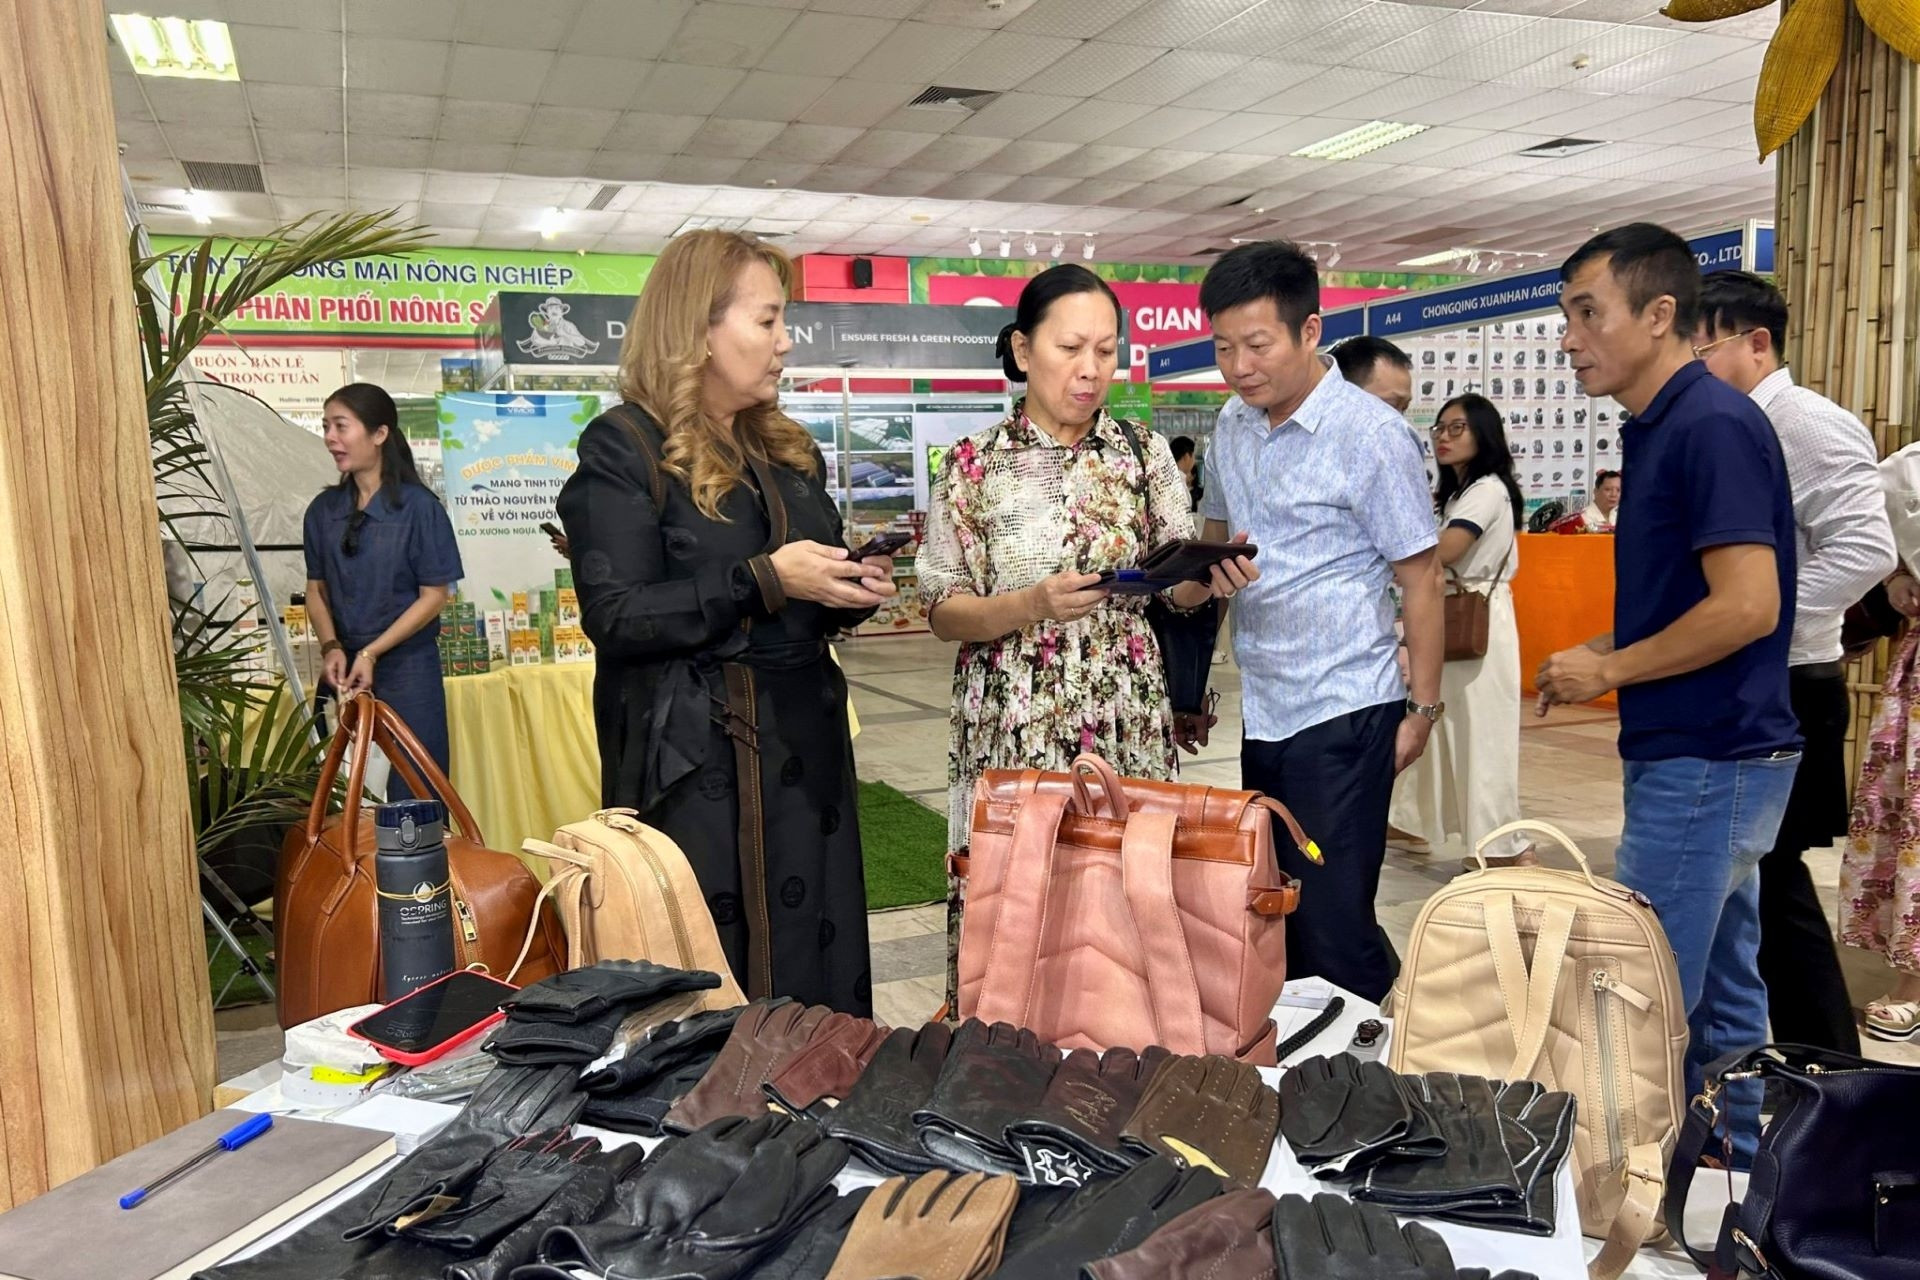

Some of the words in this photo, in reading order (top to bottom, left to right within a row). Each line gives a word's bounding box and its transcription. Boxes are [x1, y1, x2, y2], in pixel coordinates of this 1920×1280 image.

[1718, 245, 1742, 262] LTD
[354, 261, 398, 285] MẠI
[406, 259, 477, 284] NÔNG
[485, 263, 573, 289] NGHIỆP
[237, 292, 311, 321] PHÂN
[320, 291, 381, 322] PHỐI
[389, 294, 460, 324] NÔNG
[1385, 312, 1401, 325] A44
[1422, 299, 1478, 319] CHONGQING
[1479, 287, 1529, 308] XUANHAN
[1531, 281, 1563, 298] AGRIC
[1135, 306, 1202, 331] GIAN
[841, 333, 879, 342] ENSURE
[880, 334, 910, 342] FRESH
[911, 334, 919, 343] &
[920, 335, 951, 343] GREEN
[952, 335, 998, 344] FOODSTUF
[194, 353, 237, 368] BUÔN
[1160, 358, 1170, 368] A41
[551, 455, 577, 472] VIM
[490, 480, 521, 488] MANG
[524, 479, 547, 488] TINH
[504, 495, 547, 505] NGUYÊN
[458, 528, 477, 537] CAO
[400, 899, 447, 916] OSPRING
